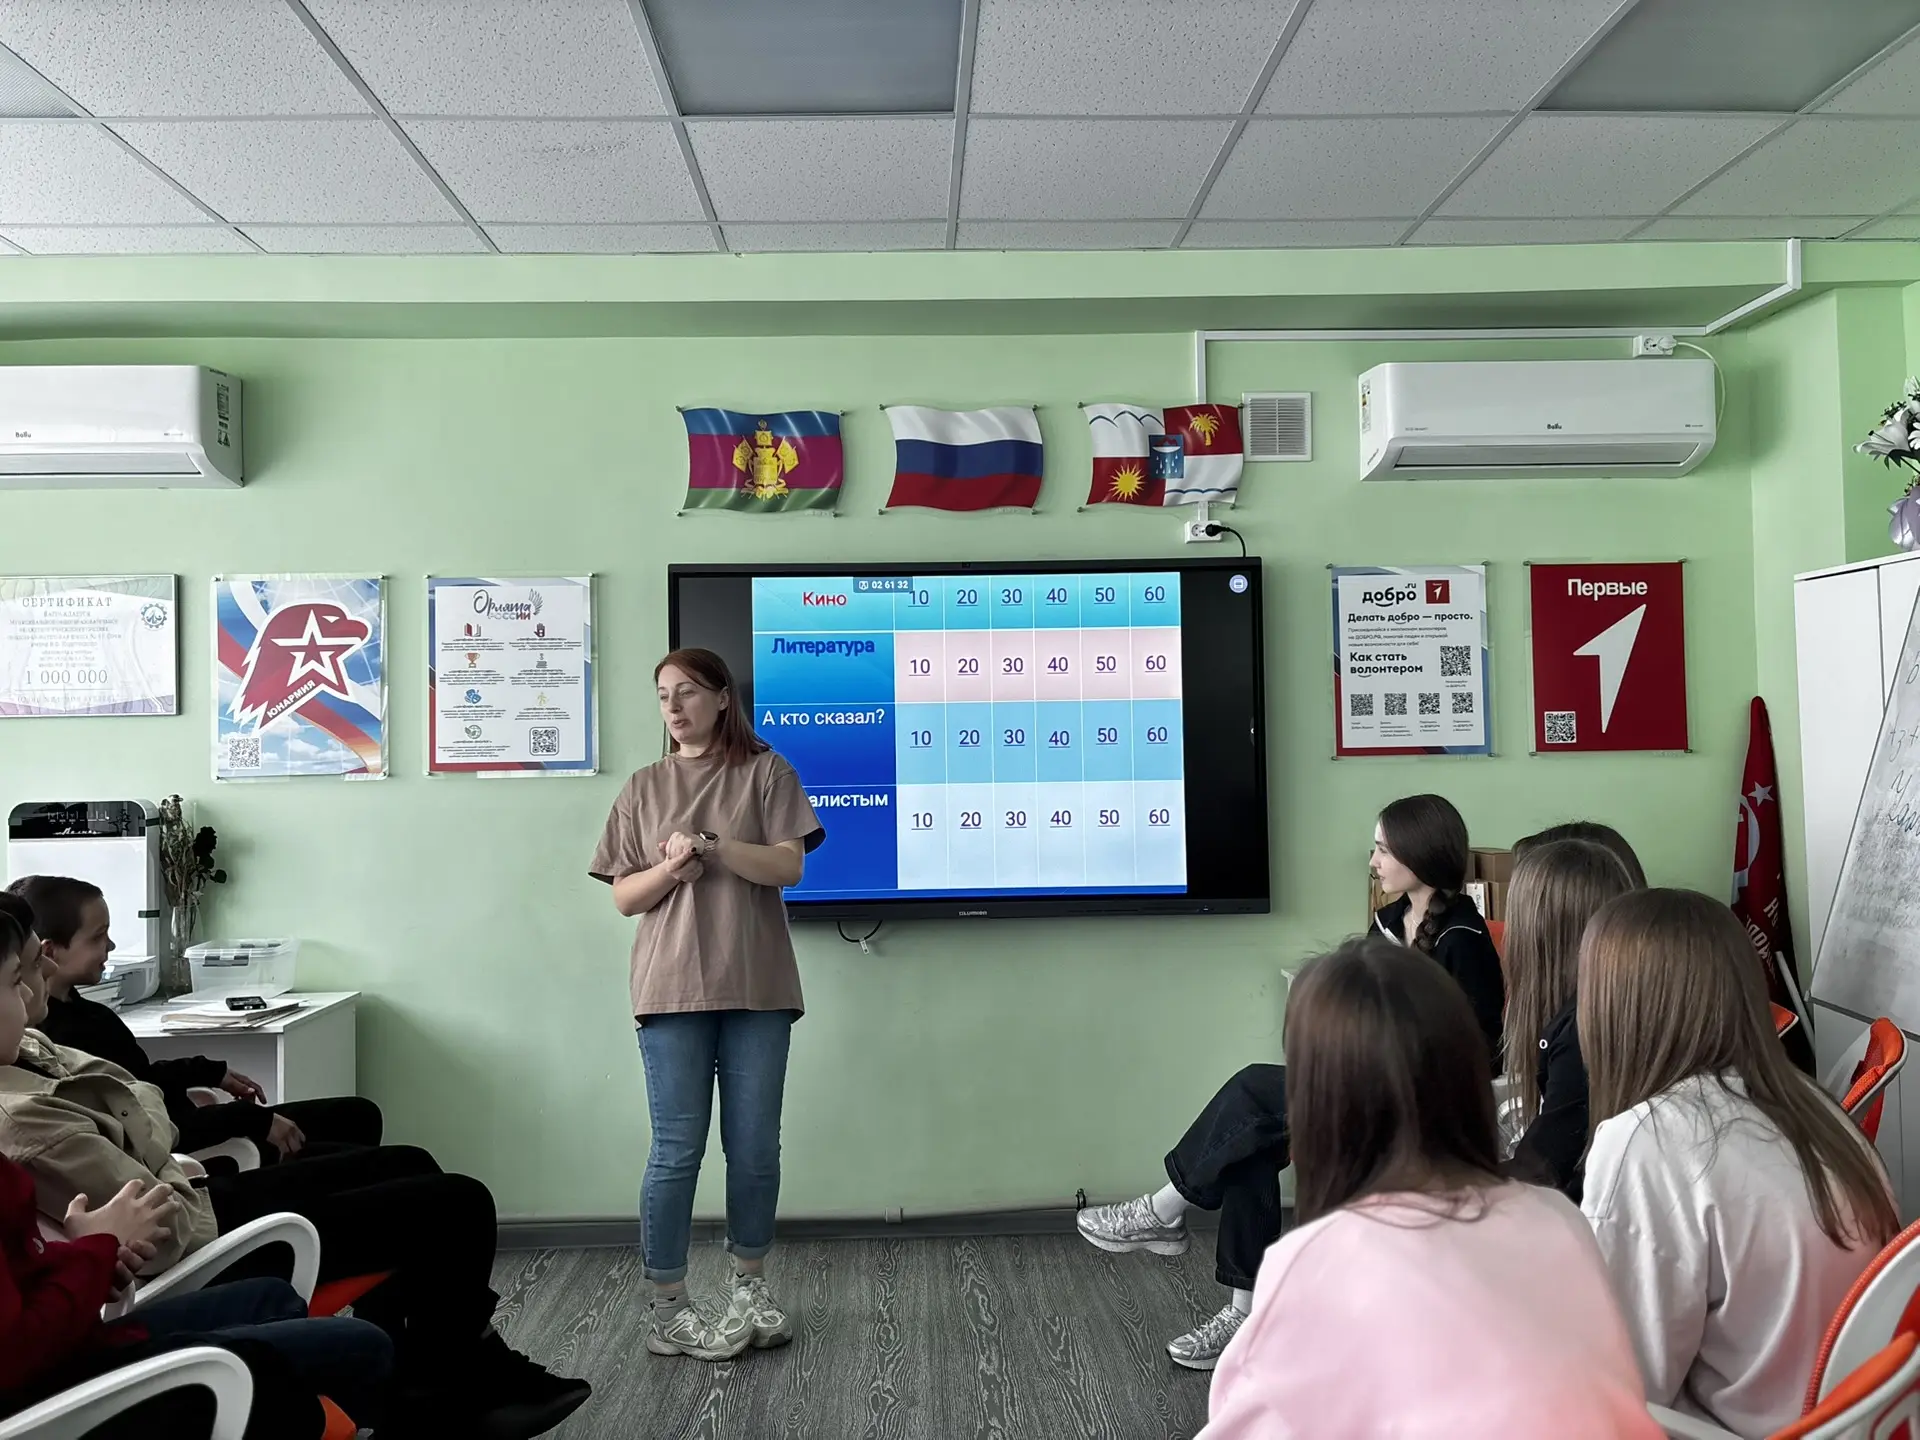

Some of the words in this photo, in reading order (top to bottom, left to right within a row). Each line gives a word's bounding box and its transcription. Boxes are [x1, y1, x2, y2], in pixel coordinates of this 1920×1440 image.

[872, 581, 882, 589] 02
[1568, 578, 1648, 600] Первые
[22, 597, 112, 608] СЕРТИФИКАТ
[474, 589, 532, 616] Орлята
[803, 592, 846, 606] Кино
[908, 590, 929, 604] 10
[957, 590, 977, 604] 20
[1002, 589, 1022, 604] 30
[1046, 588, 1067, 603] 40
[1095, 587, 1115, 602] 50
[1144, 586, 1165, 601] 60
[1362, 587, 1416, 604] добро
[1348, 614, 1385, 623] Делать
[1388, 612, 1420, 622] добро
[1435, 614, 1473, 622] просто.
[771, 638, 875, 657] Литература
[910, 659, 930, 674] 10
[958, 659, 978, 673] 20
[1002, 658, 1023, 672] 30
[1047, 657, 1068, 672] 40
[1096, 656, 1116, 670] 50
[1146, 655, 1166, 670] 60
[1350, 652, 1372, 661] Как
[1375, 653, 1407, 661] стать
[26, 670, 32, 684] 1
[41, 670, 70, 684] 000
[78, 670, 108, 684] 000
[1350, 665, 1423, 675] волонтером
[266, 680, 316, 718] ЮНАРМИЯ
[762, 710, 775, 725] А
[781, 713, 809, 725] кто
[815, 709, 885, 725] сказал?
[911, 730, 932, 746] 10
[959, 730, 980, 745] 20
[1004, 729, 1025, 744] 30
[1049, 731, 1070, 746] 40
[1097, 728, 1117, 743] 50
[1147, 727, 1168, 742] 60
[912, 813, 933, 828] 10
[961, 812, 981, 826] 20
[1006, 811, 1026, 826] 30
[1050, 810, 1071, 825] 40
[1099, 810, 1119, 825] 50
[1149, 809, 1169, 824] 60
